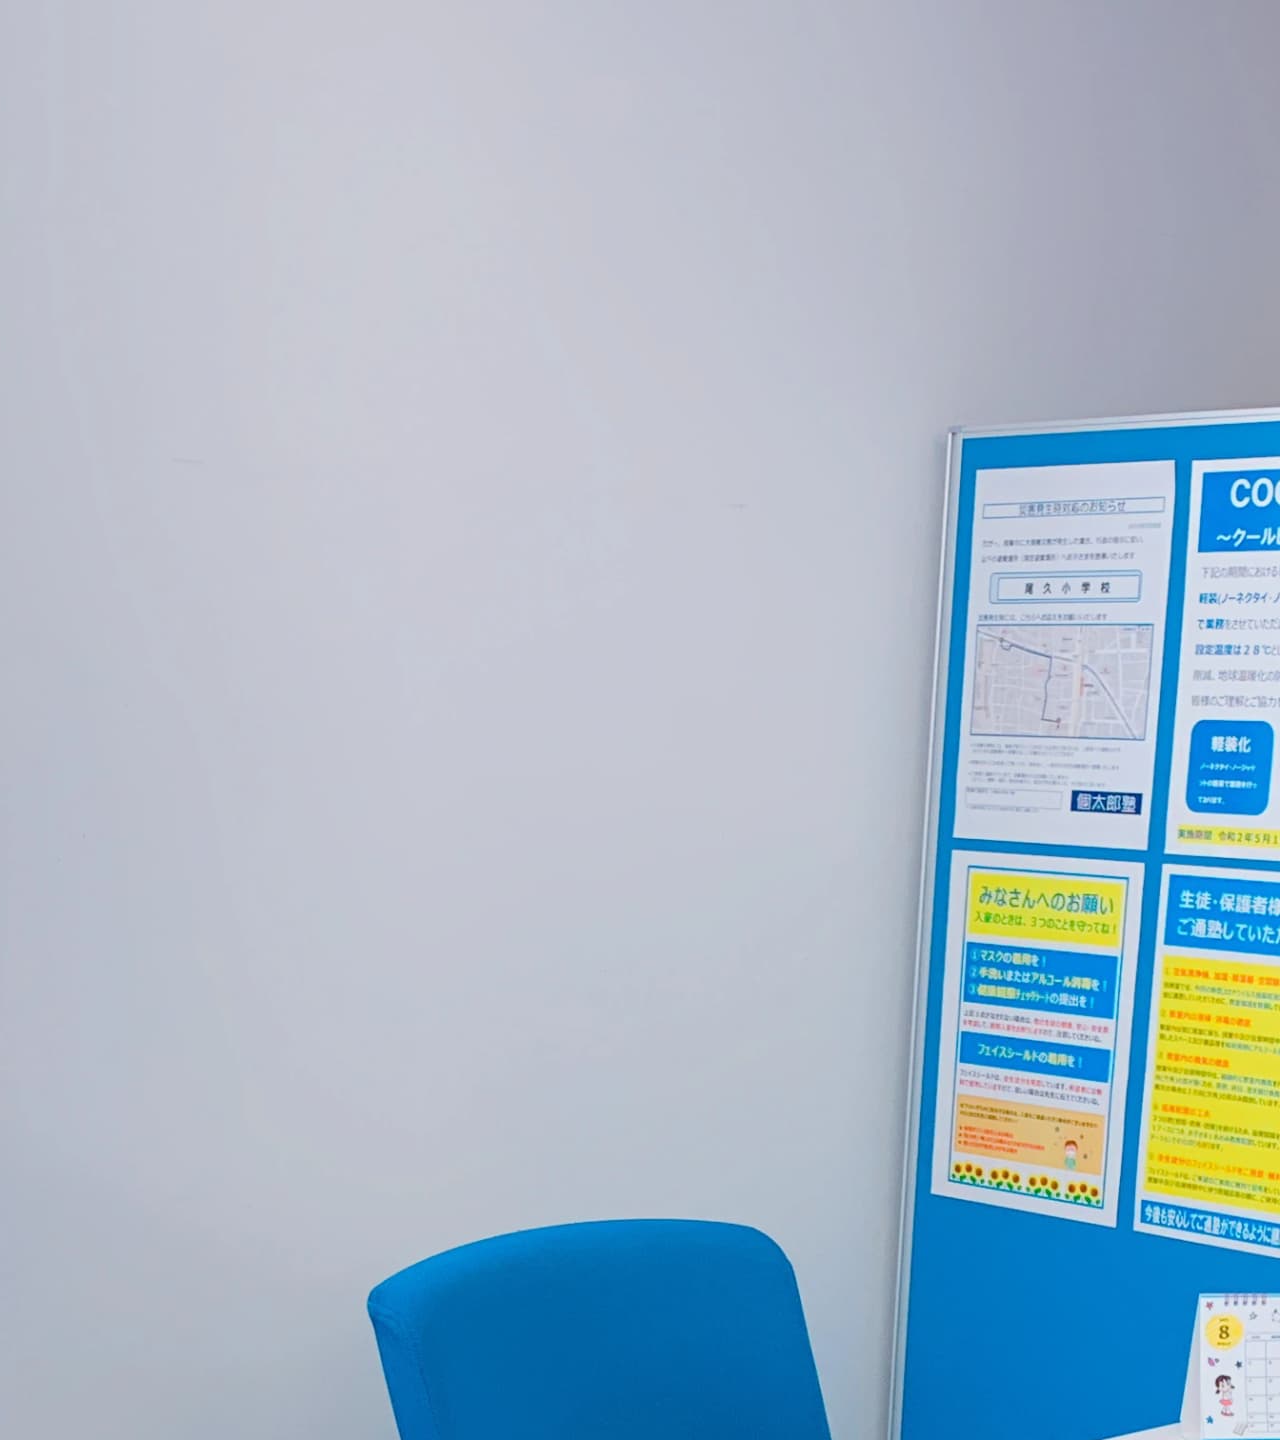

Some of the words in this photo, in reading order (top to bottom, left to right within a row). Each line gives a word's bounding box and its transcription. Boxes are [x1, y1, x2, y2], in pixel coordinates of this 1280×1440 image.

[1024, 581, 1112, 596] 尾久小学校
[1211, 735, 1252, 754] 軽装化
[1076, 792, 1137, 814] 個太郎塾
[978, 885, 1115, 916] みなさんへのお願い
[1218, 1324, 1230, 1340] 8
